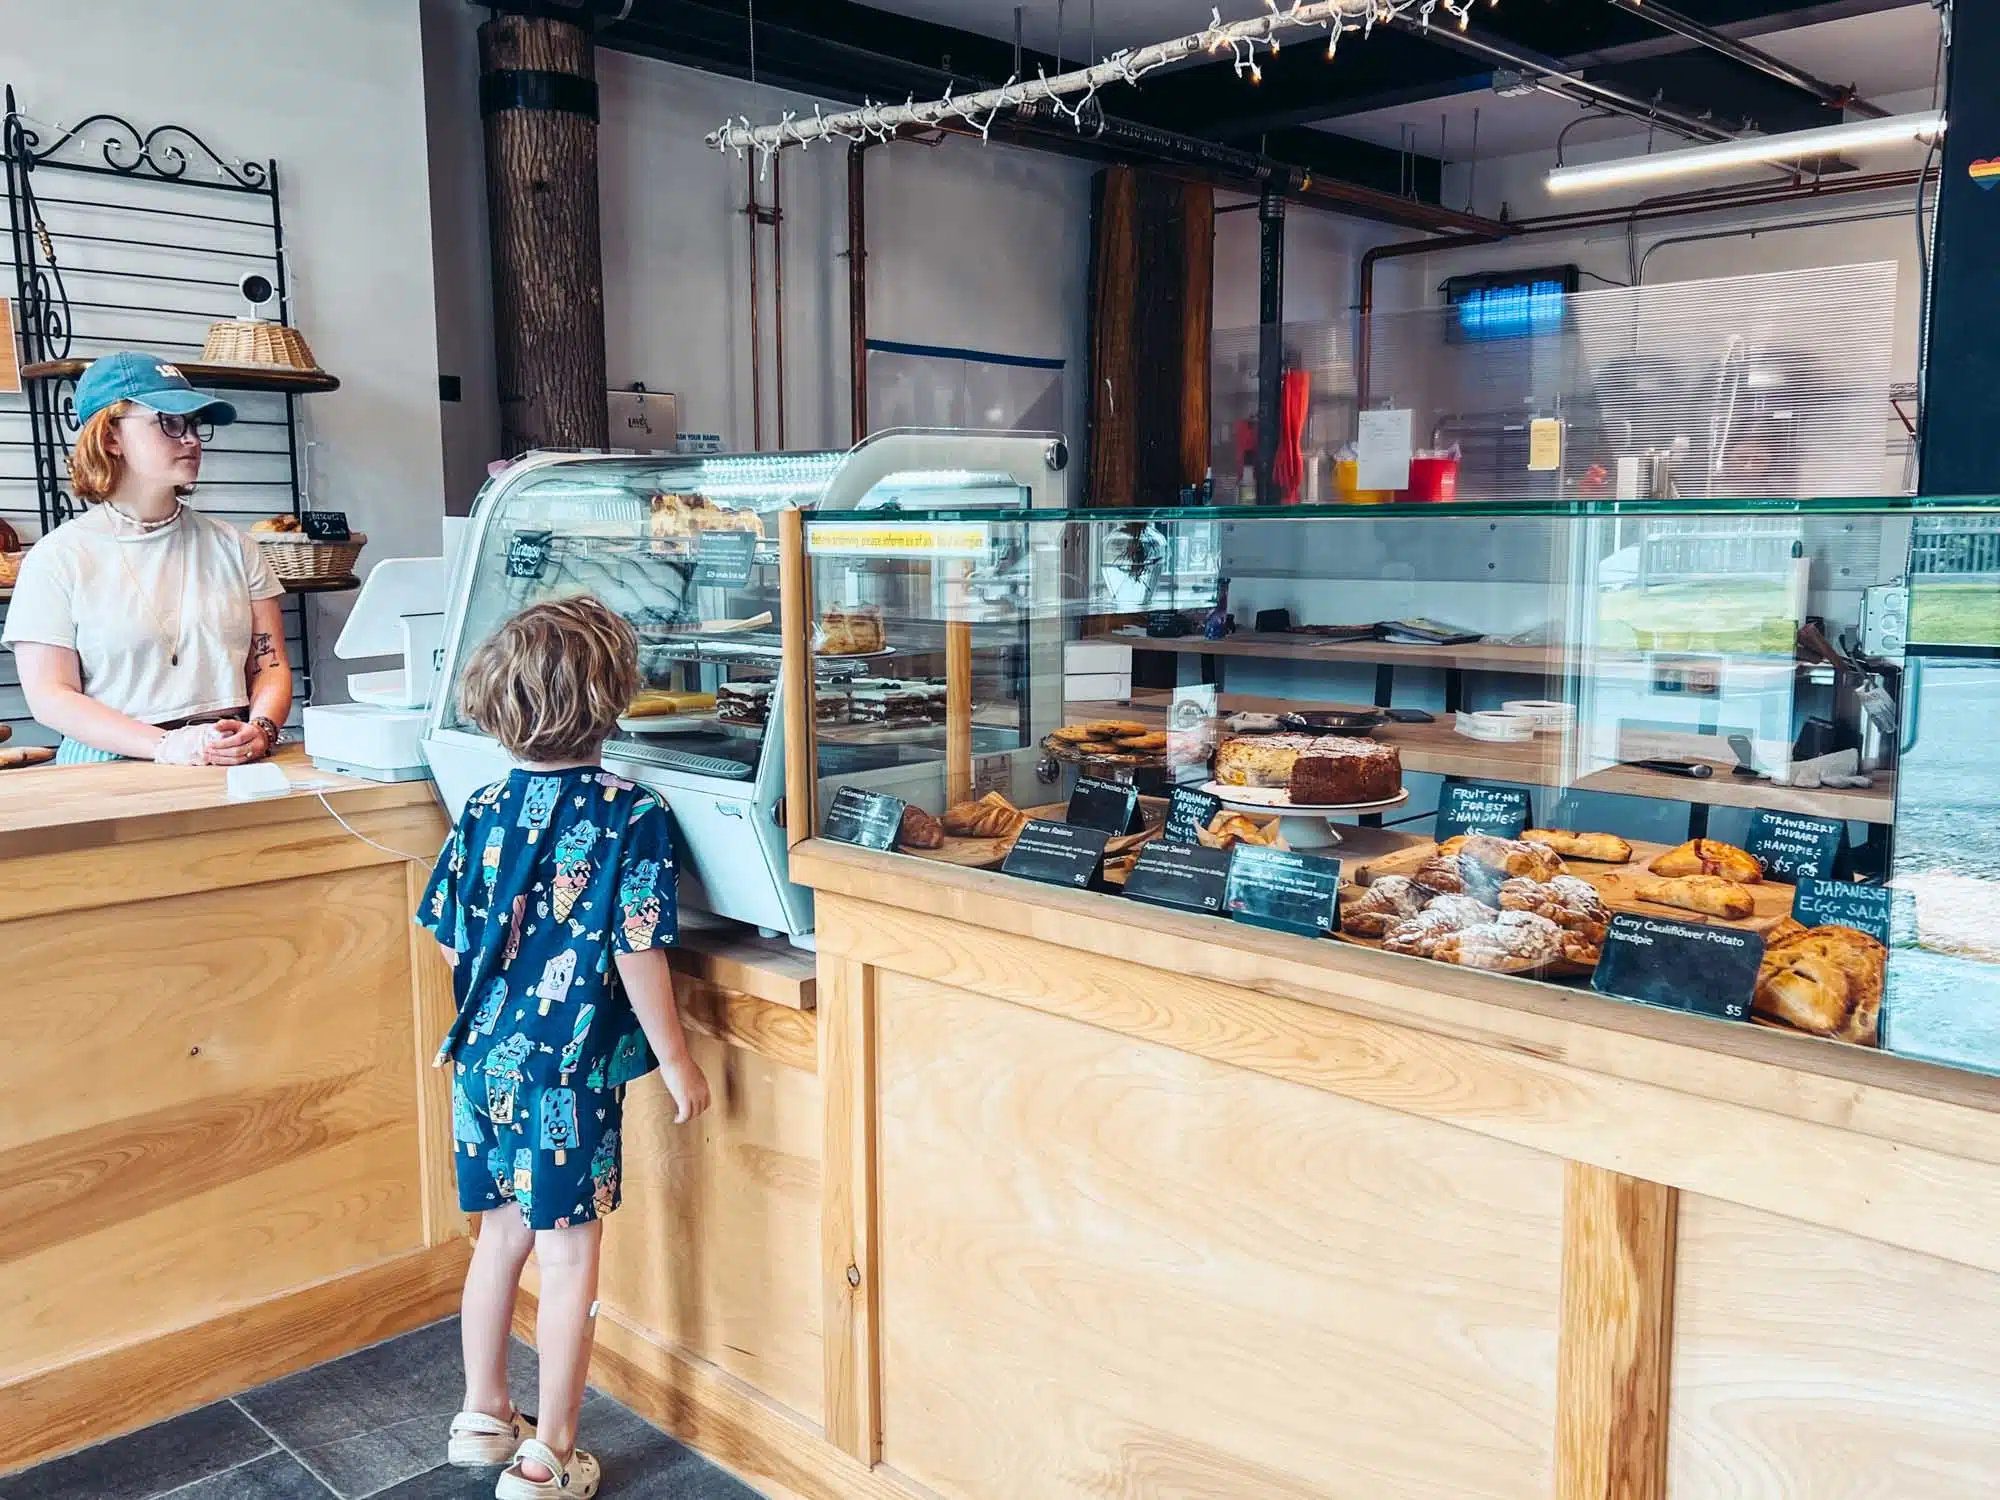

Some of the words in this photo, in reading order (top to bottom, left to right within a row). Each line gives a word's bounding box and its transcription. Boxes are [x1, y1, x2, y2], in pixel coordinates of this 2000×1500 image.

[1460, 800, 1508, 813] FOREST
[1761, 814, 1837, 834] STRAWBERRY
[1774, 827, 1819, 844] RHUBARB
[1763, 840, 1813, 856] HANDPIE
[1772, 855, 1794, 873] $5
[1074, 873, 1086, 883] $6
[1813, 880, 1887, 901] JAPANESE
[1203, 896, 1217, 906] $3
[1799, 896, 1841, 914] EGG
[1846, 903, 1889, 923] SALA
[1315, 915, 1329, 927] $6
[1609, 929, 1654, 946] Handpie
[1613, 915, 1642, 931] Curry
[1644, 921, 1705, 940] Cauliflower
[1706, 931, 1745, 947] Potato
[1725, 1004, 1742, 1017] $5
